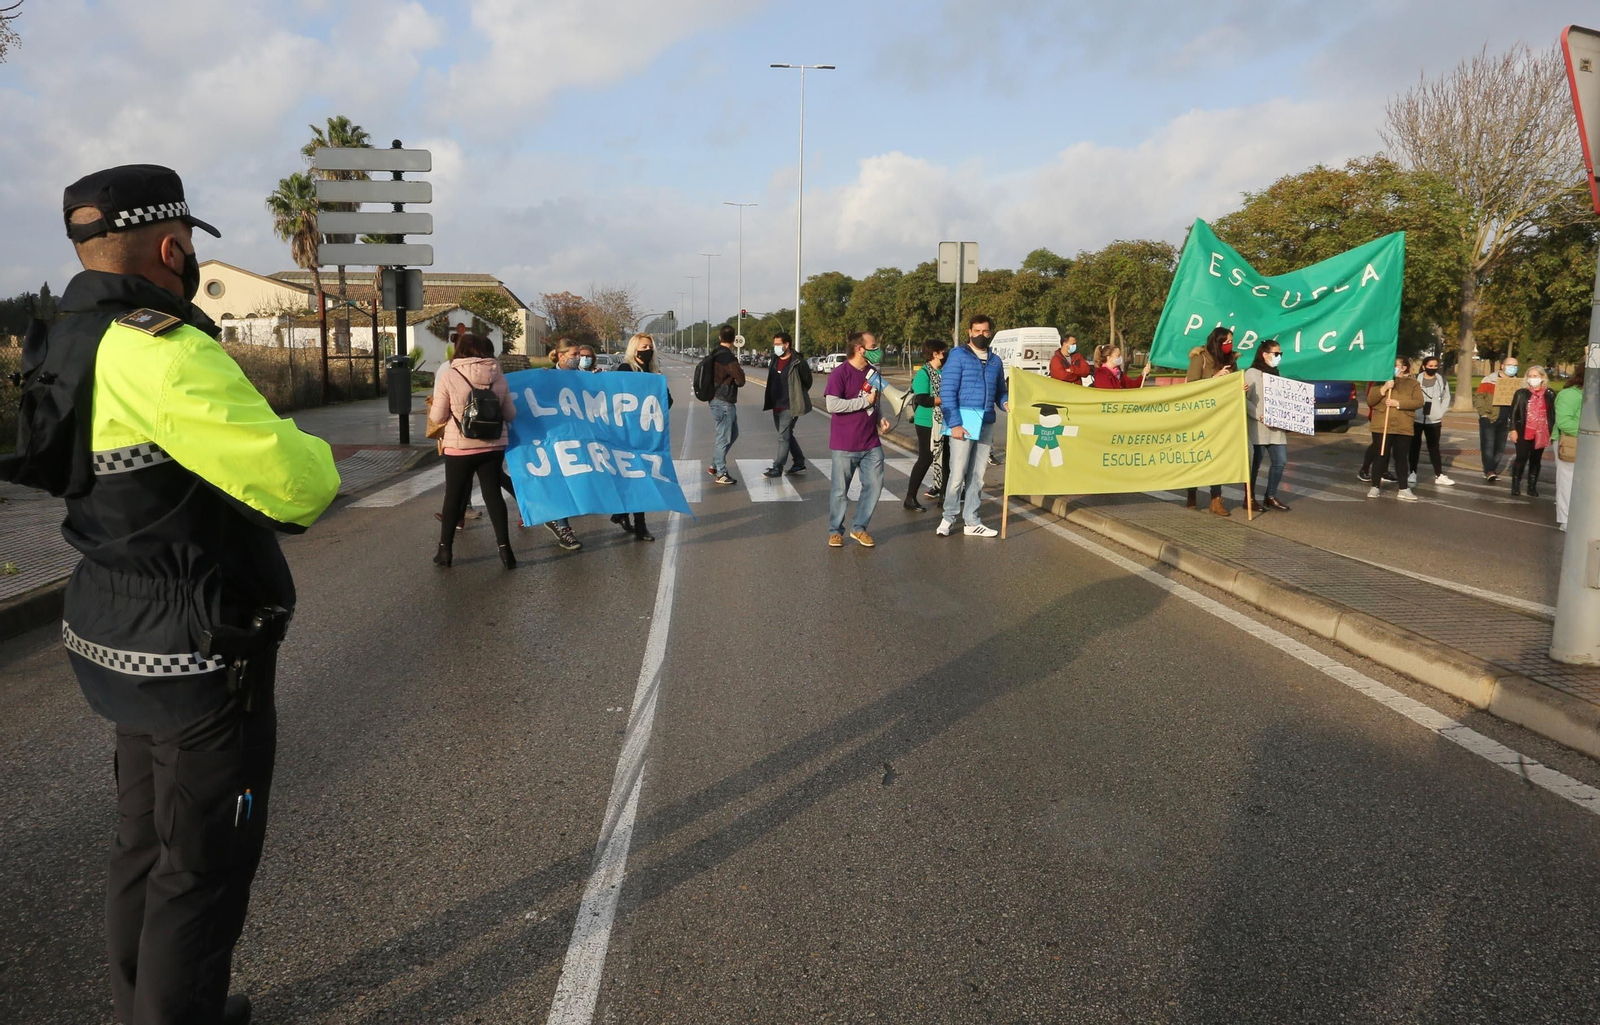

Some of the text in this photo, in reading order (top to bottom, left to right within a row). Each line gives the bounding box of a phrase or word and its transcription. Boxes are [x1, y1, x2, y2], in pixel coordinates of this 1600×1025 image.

[1183, 312, 1365, 353] PBICA
[508, 386, 665, 433] LAMPA
[1101, 399, 1216, 414] IES FERNANDO SAVATER
[1111, 430, 1205, 445] EN DEFENSA DE LA
[1102, 447, 1213, 467] ESCUELA PÚBLICA
